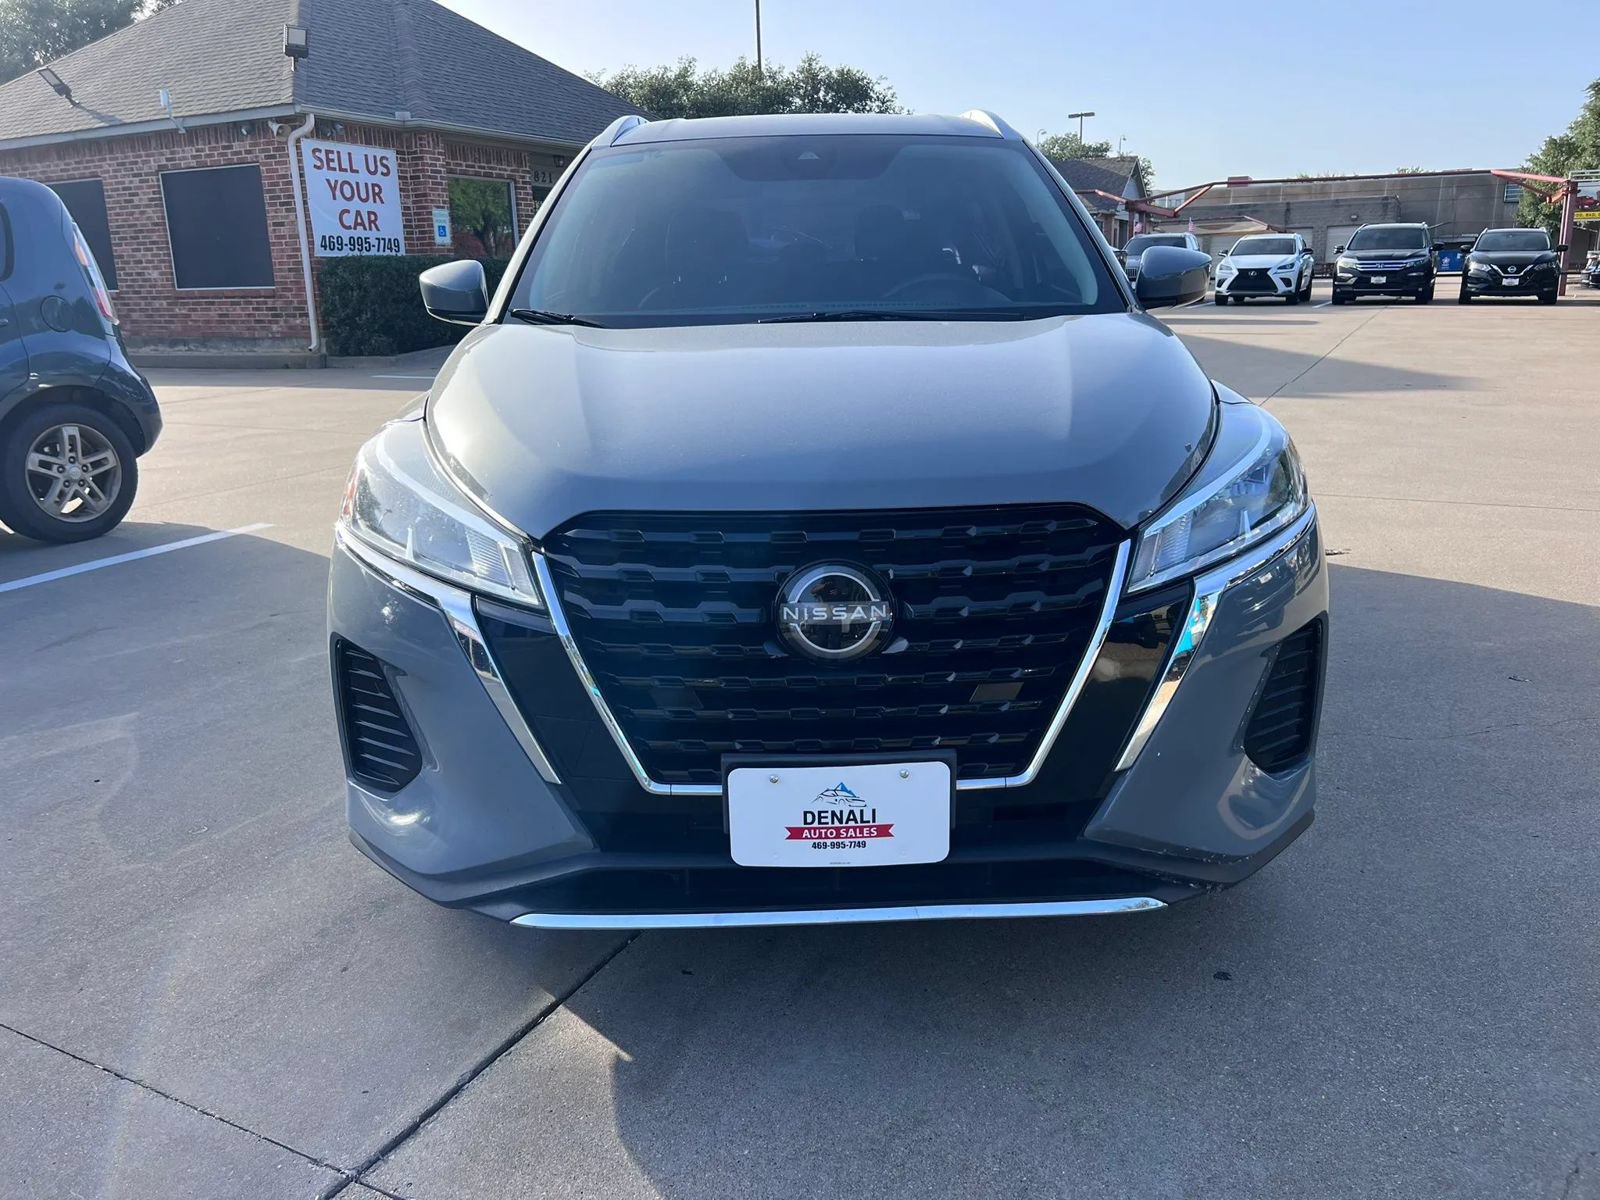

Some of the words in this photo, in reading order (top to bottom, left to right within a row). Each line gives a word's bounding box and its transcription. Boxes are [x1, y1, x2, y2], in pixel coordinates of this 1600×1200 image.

[312, 147, 359, 174] SELL
[364, 154, 391, 177] US
[326, 178, 384, 204] YOUR
[338, 208, 380, 232] CAR
[320, 234, 400, 253] 469-995-7749
[783, 604, 886, 620] NISSAN
[803, 808, 876, 826] DENALI
[803, 829, 836, 838] AUTO
[840, 827, 877, 837] SALES
[811, 840, 867, 849] 469-995-7749
